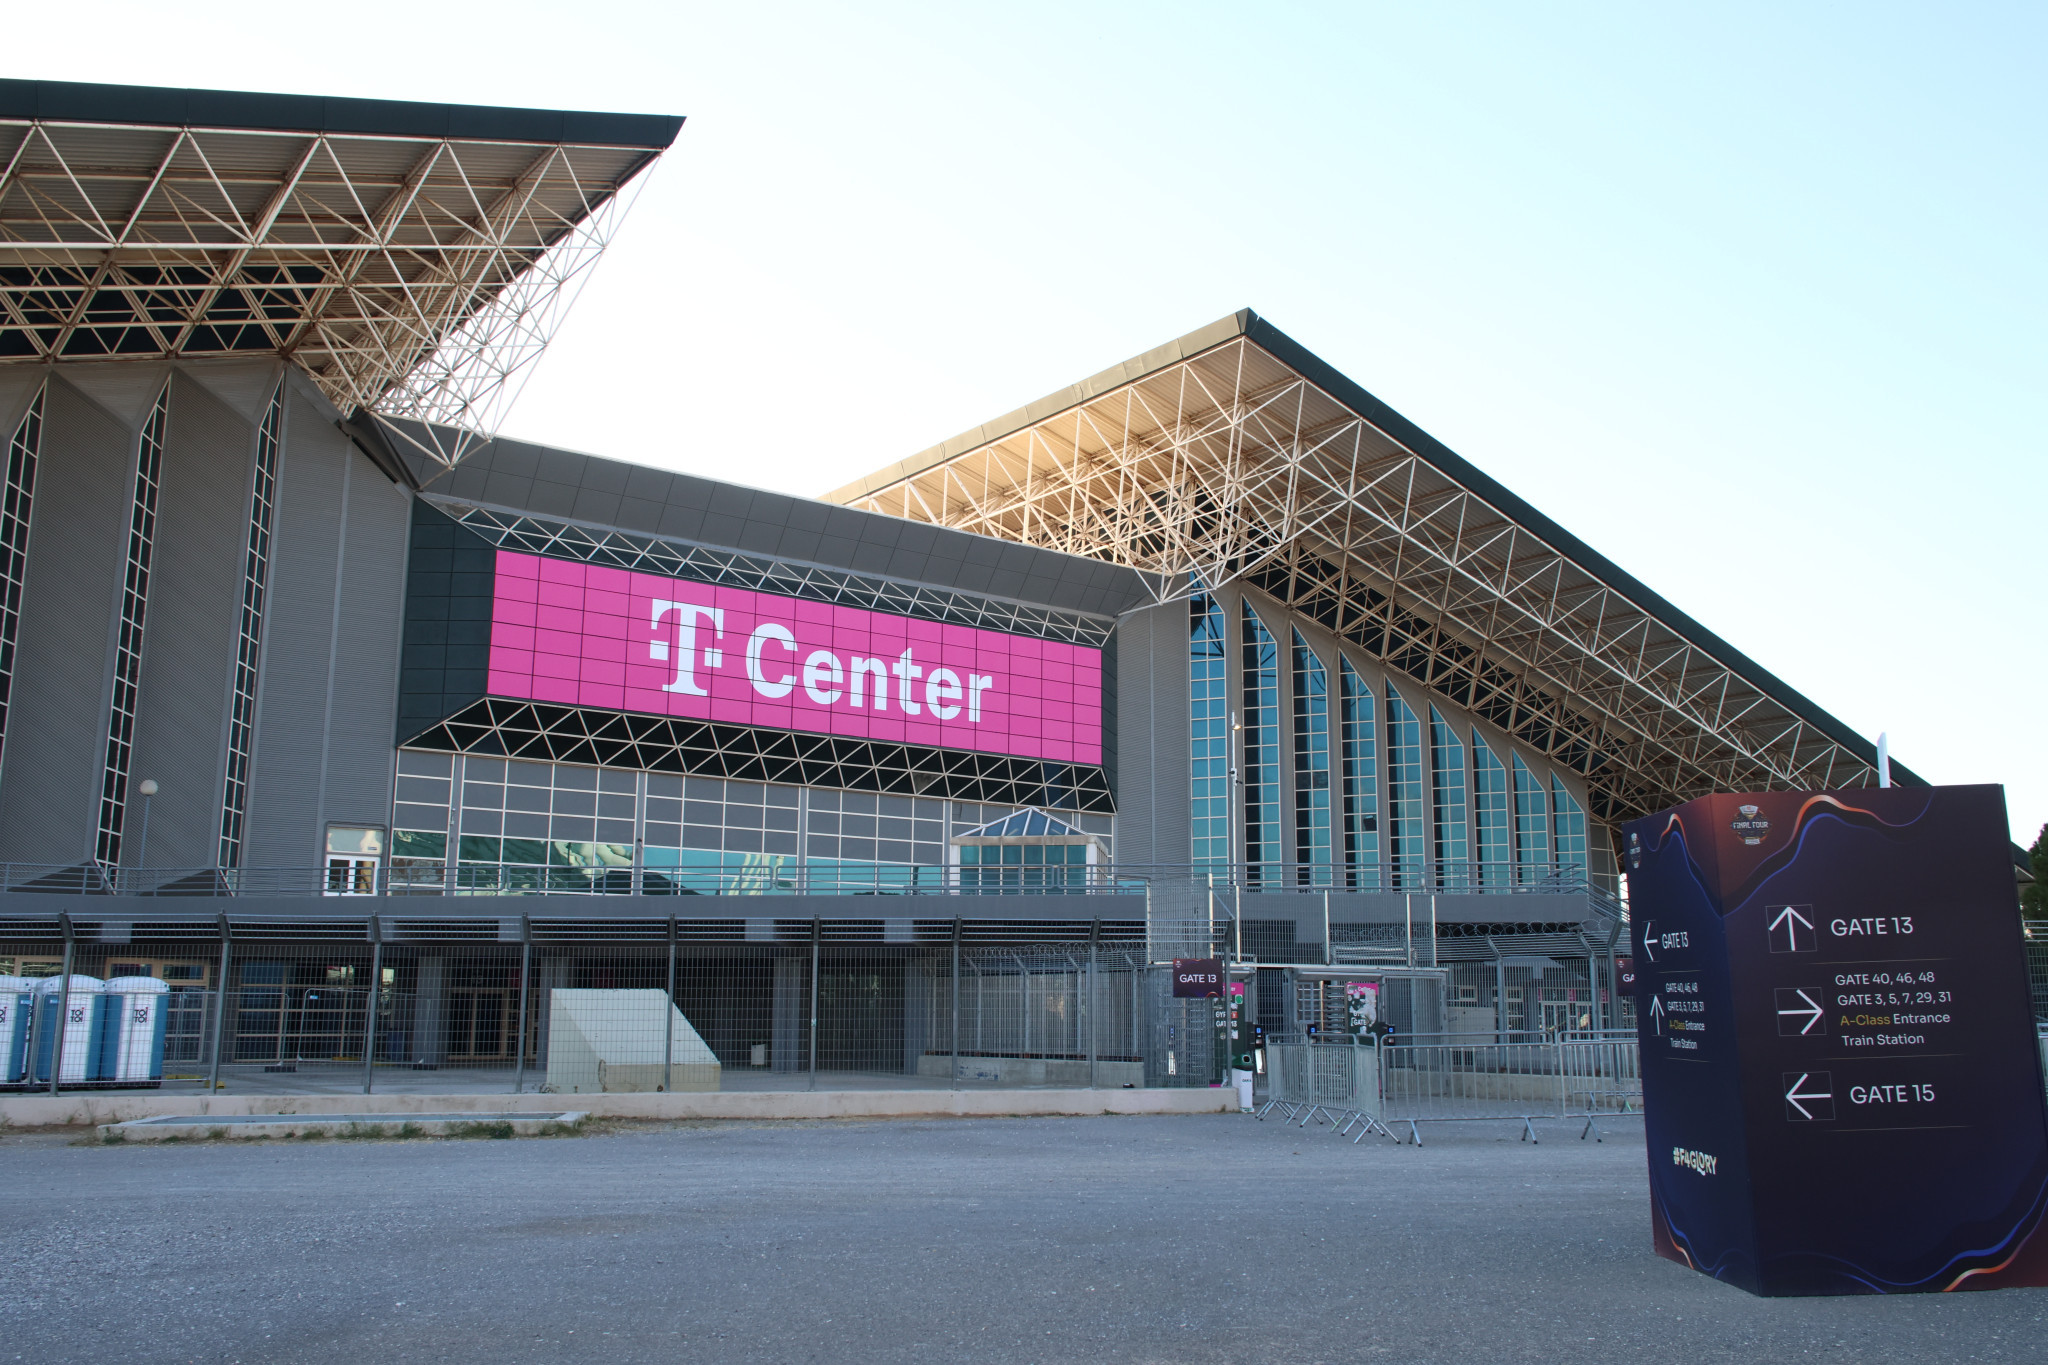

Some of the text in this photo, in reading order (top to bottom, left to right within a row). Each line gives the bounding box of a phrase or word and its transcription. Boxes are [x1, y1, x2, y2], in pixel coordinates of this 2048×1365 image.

[745, 622, 993, 723] Center
[1752, 821, 1769, 829] FOUR
[1831, 916, 1914, 936] GATE 13
[1662, 931, 1688, 949] GATE 13
[1179, 974, 1217, 983] GATE 13
[1835, 971, 1935, 986] GATE 40, 46, 48
[1665, 982, 1677, 992] GATE
[1837, 991, 1951, 1006] GATE 3, 5, 7, 29, 31
[1667, 1001, 1679, 1011] GATE
[1685, 1020, 1705, 1031] Entrance
[1840, 1013, 1951, 1026] A-Class Entrance
[1670, 1037, 1697, 1049] Train Station
[1841, 1033, 1925, 1046] Train Station
[1850, 1084, 1935, 1104] GATE 15
